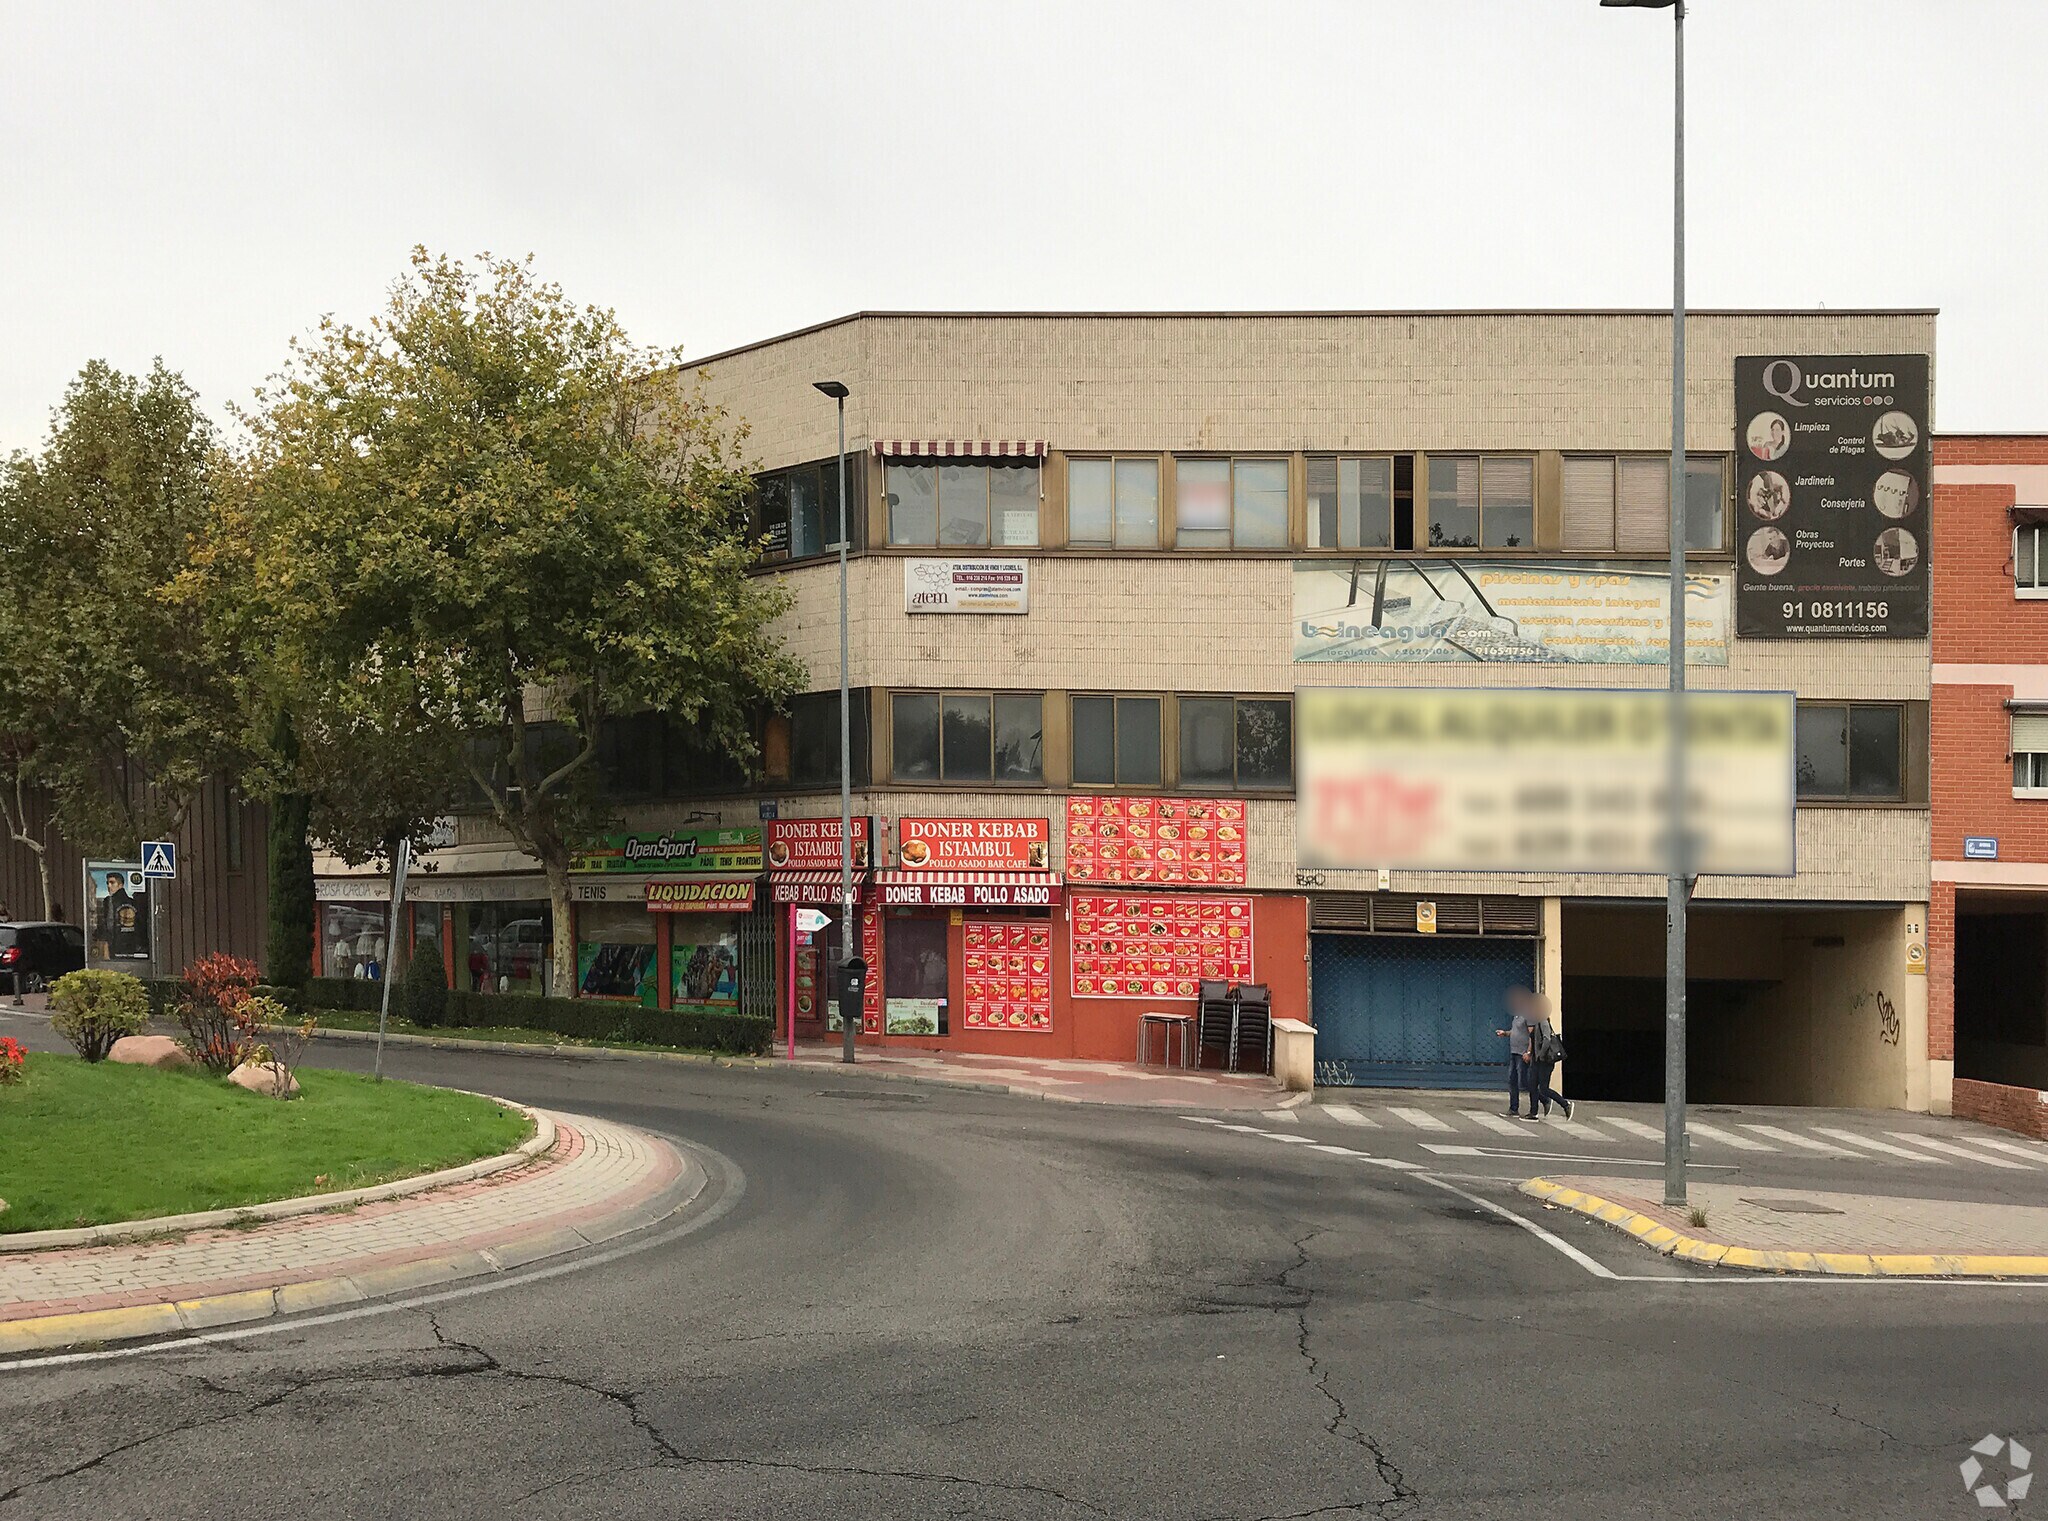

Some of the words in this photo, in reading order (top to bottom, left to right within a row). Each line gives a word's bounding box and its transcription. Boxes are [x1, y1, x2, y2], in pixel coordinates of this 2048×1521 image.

[1762, 360, 1895, 407] Quantum
[1814, 395, 1861, 406] servicios
[1794, 422, 1830, 434] Limpieza
[1837, 436, 1866, 445] Control
[1829, 446, 1839, 454] de
[1840, 446, 1865, 455] Plagas
[1795, 529, 1819, 539] Obras
[1795, 540, 1835, 550] Proyectos
[1838, 557, 1866, 568] Portes
[1480, 572, 1563, 587] piscinas
[1568, 575, 1580, 588] y
[1585, 575, 1631, 588] spas
[912, 591, 949, 604] atem
[1498, 596, 1602, 606] mantenimiento
[1605, 597, 1661, 610] integral
[1782, 602, 1803, 618] 91
[1811, 602, 1889, 618] 0811156
[1519, 616, 1574, 626] escuela
[1786, 623, 1887, 633] www.quantumservicios.com
[775, 823, 818, 838] DONER
[910, 822, 974, 838] DONER
[978, 822, 1038, 838] KEBAB
[625, 837, 697, 859] OpenSport
[794, 841, 843, 857] ISTAMBU
[939, 840, 1015, 857] ISTAMBUL
[787, 859, 805, 868] POLLO
[806, 859, 826, 867] ASADO
[827, 859, 839, 867] BAR
[929, 859, 956, 868] POLLO
[957, 859, 986, 868] ASADO
[987, 859, 1005, 868] BAR
[578, 886, 607, 899] TENIS
[648, 883, 751, 902] LIQUIDACION
[775, 886, 799, 901] KEBAB
[802, 885, 827, 902] POLLO
[885, 886, 922, 903] DONER
[930, 886, 966, 903] KEBAB
[974, 886, 1008, 903] POLLO
[1013, 887, 1050, 904] ASADO
